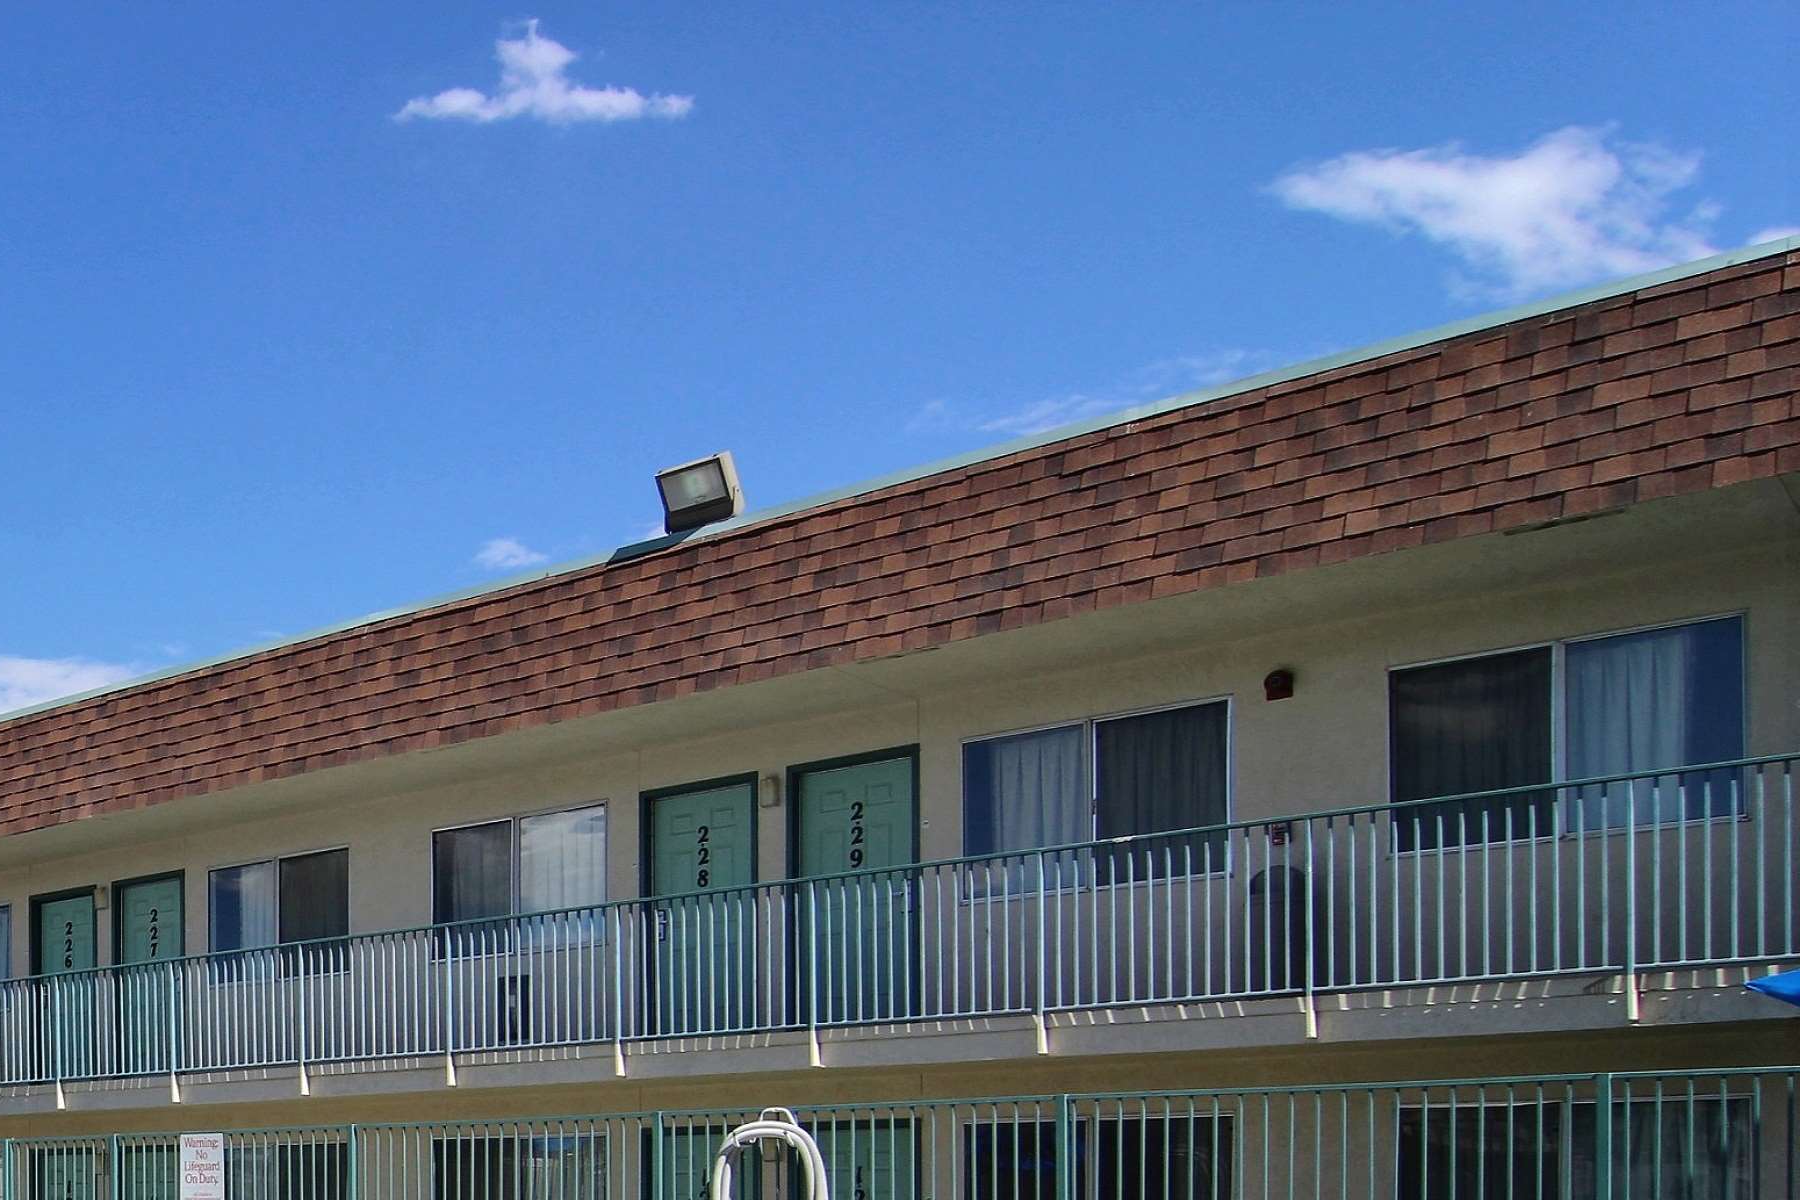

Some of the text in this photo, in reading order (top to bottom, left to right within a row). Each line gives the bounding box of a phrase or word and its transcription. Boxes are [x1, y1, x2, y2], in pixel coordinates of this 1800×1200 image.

[697, 825, 710, 888] 228
[849, 801, 864, 868] 229
[64, 921, 73, 968] 226
[149, 908, 158, 957] 227
[184, 1161, 220, 1173] Lifeguard
[195, 1149, 208, 1160] No
[185, 1173, 198, 1184] On
